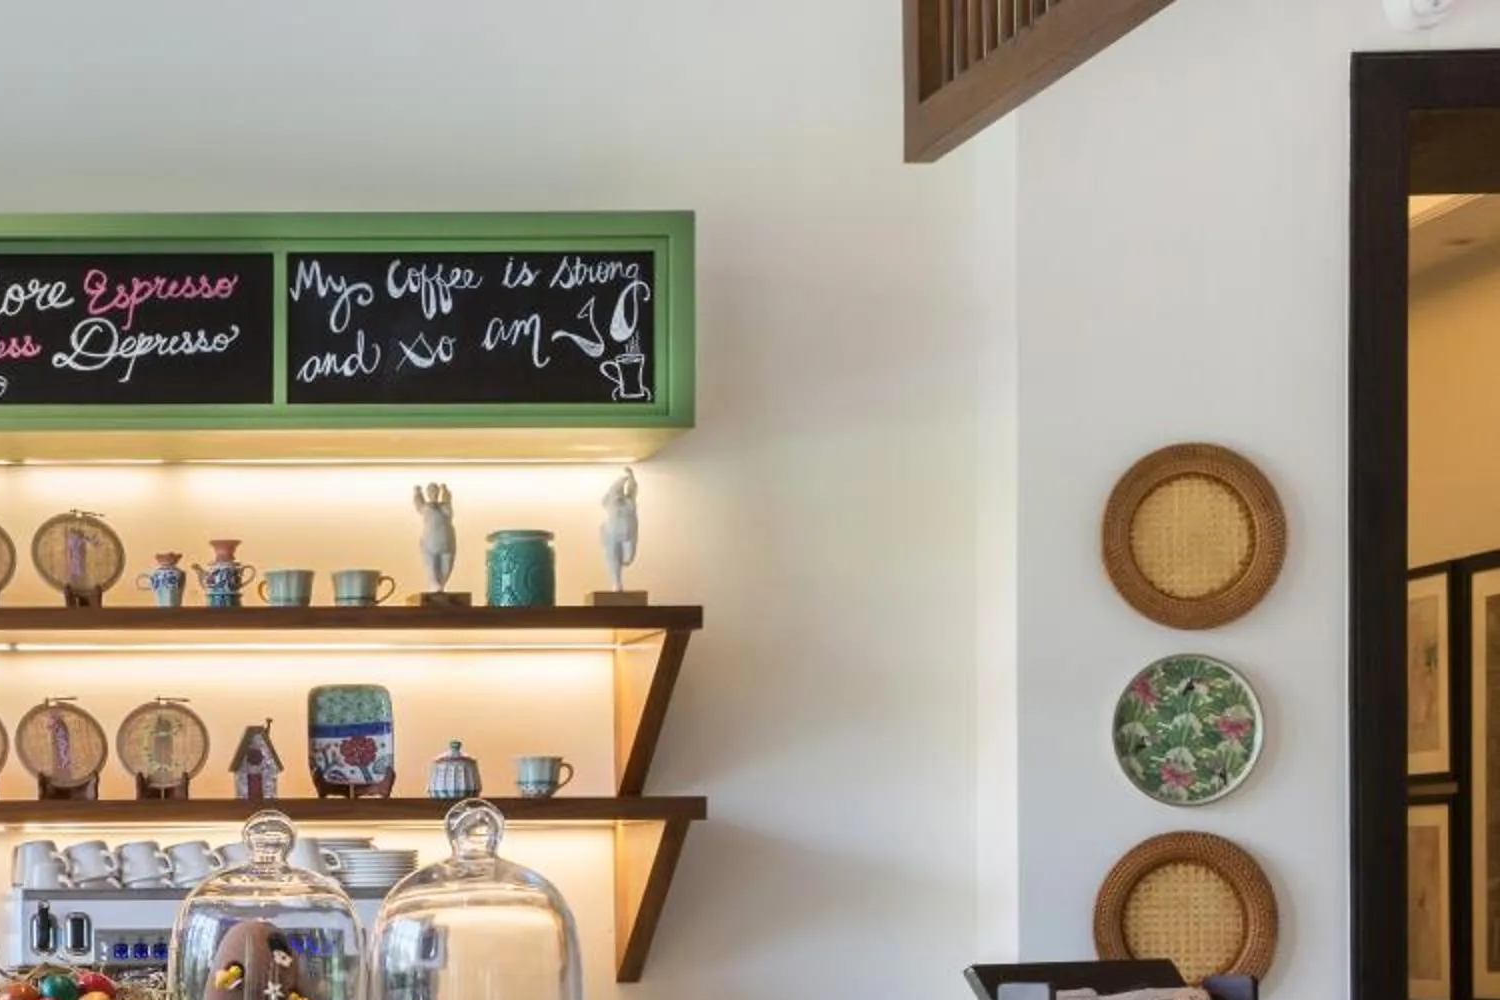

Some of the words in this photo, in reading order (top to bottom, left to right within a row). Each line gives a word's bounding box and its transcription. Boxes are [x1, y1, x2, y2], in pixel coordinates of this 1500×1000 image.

[83, 268, 239, 331] Espresso
[289, 259, 374, 333] My
[387, 259, 483, 320] Coffee
[502, 255, 541, 288] is
[51, 317, 240, 383] Depresso
[296, 329, 381, 384] and
[481, 312, 551, 369] am
